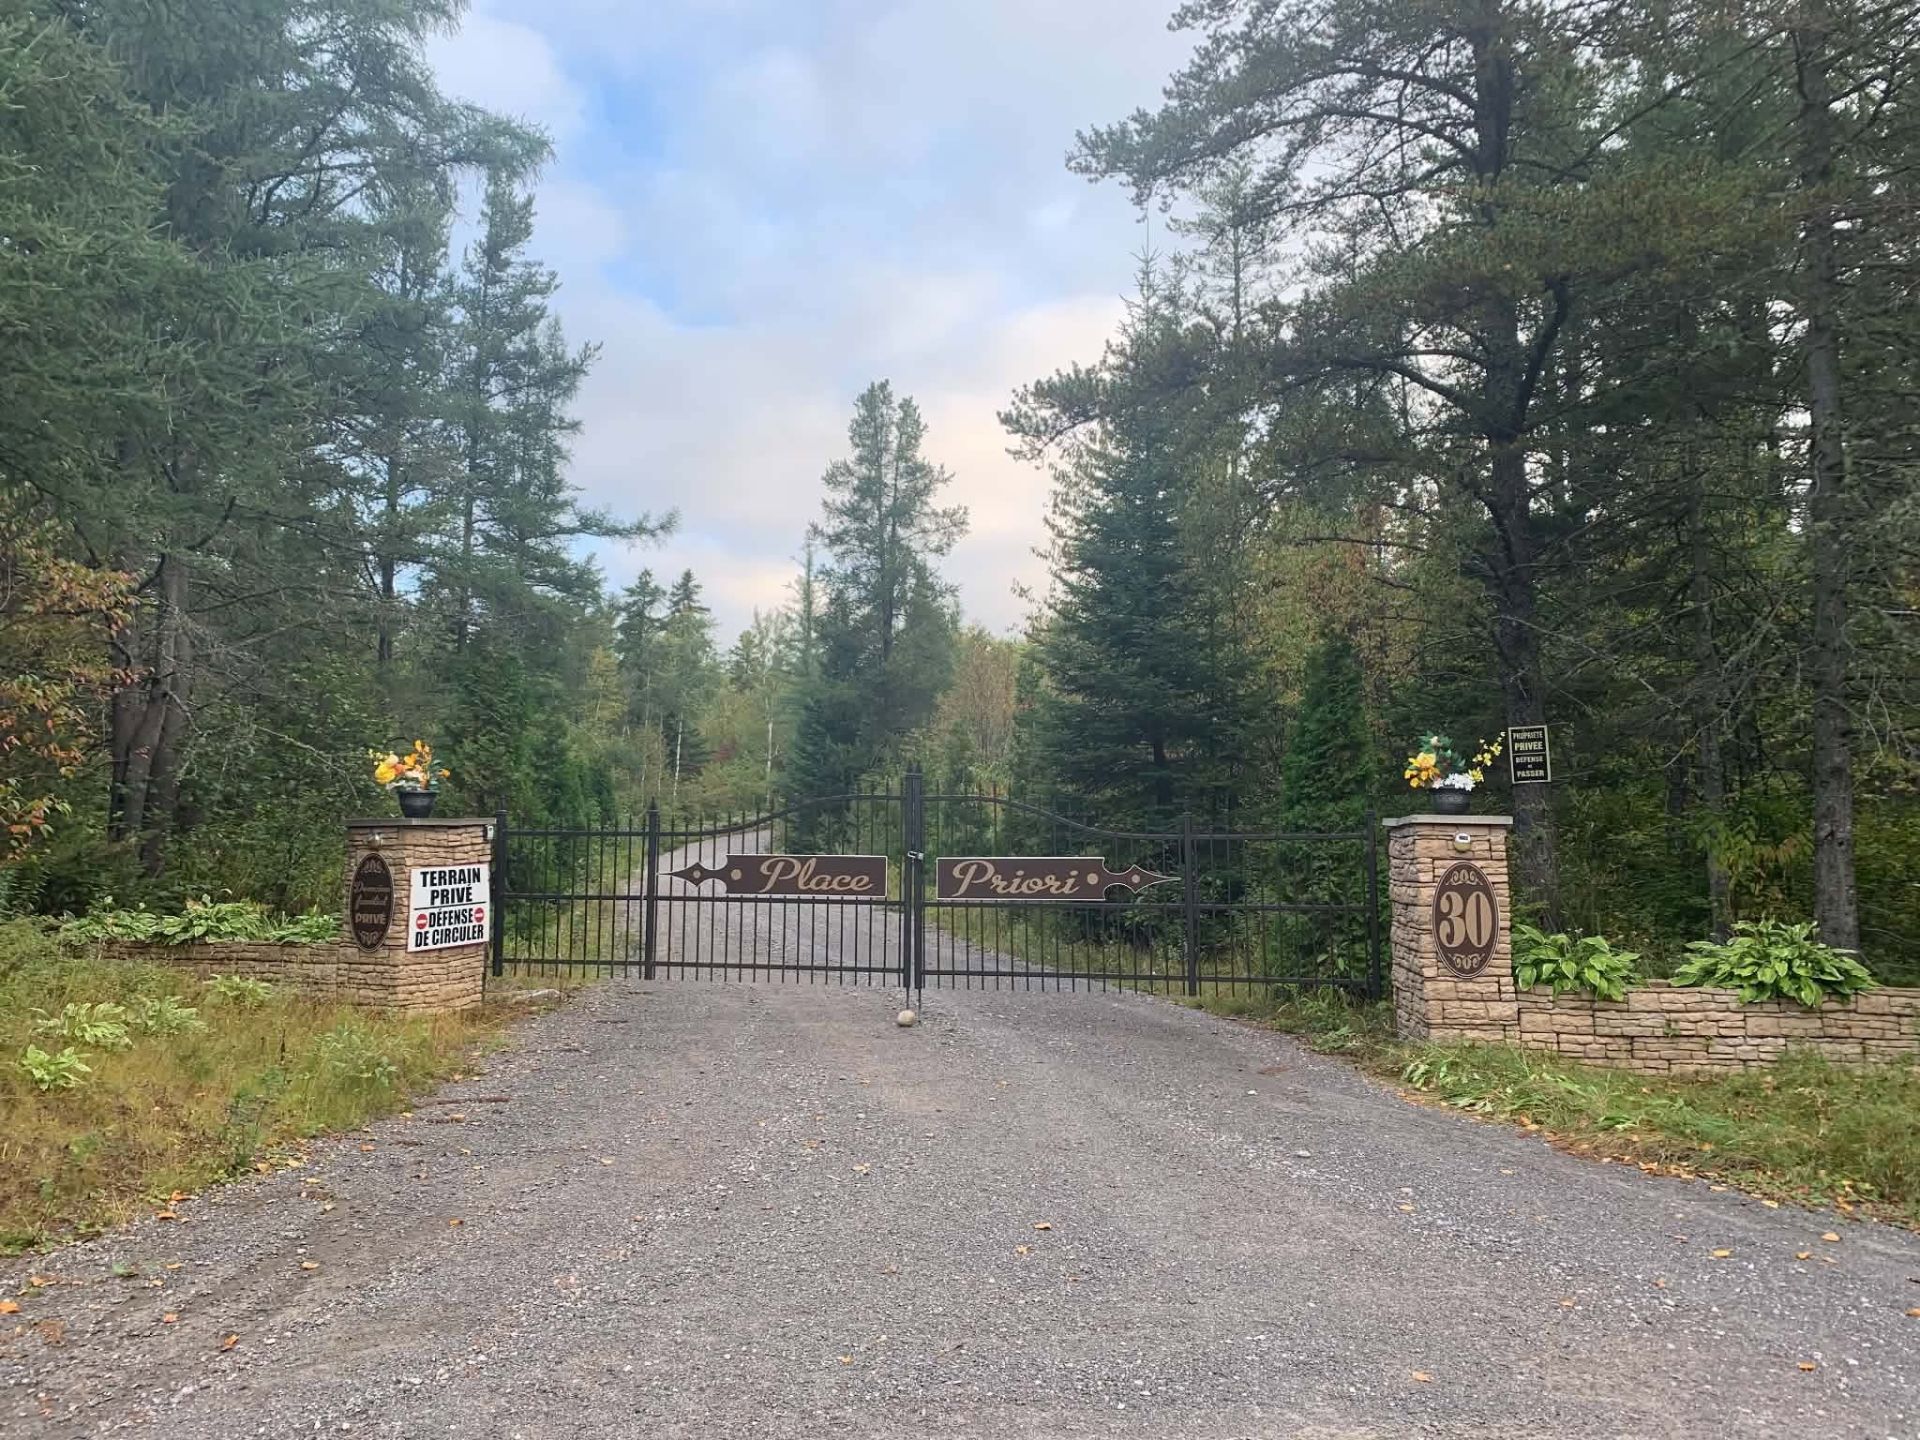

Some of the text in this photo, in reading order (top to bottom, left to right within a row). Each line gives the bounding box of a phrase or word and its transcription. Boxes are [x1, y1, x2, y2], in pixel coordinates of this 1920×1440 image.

[420, 867, 481, 888] TERRAIN
[759, 857, 873, 893] Place
[952, 860, 1080, 897] Priori
[430, 884, 473, 906] PRIVÉ
[428, 908, 474, 928] DÉFENSE
[1439, 891, 1493, 948] 30
[415, 924, 484, 947] DE CIRCULER
